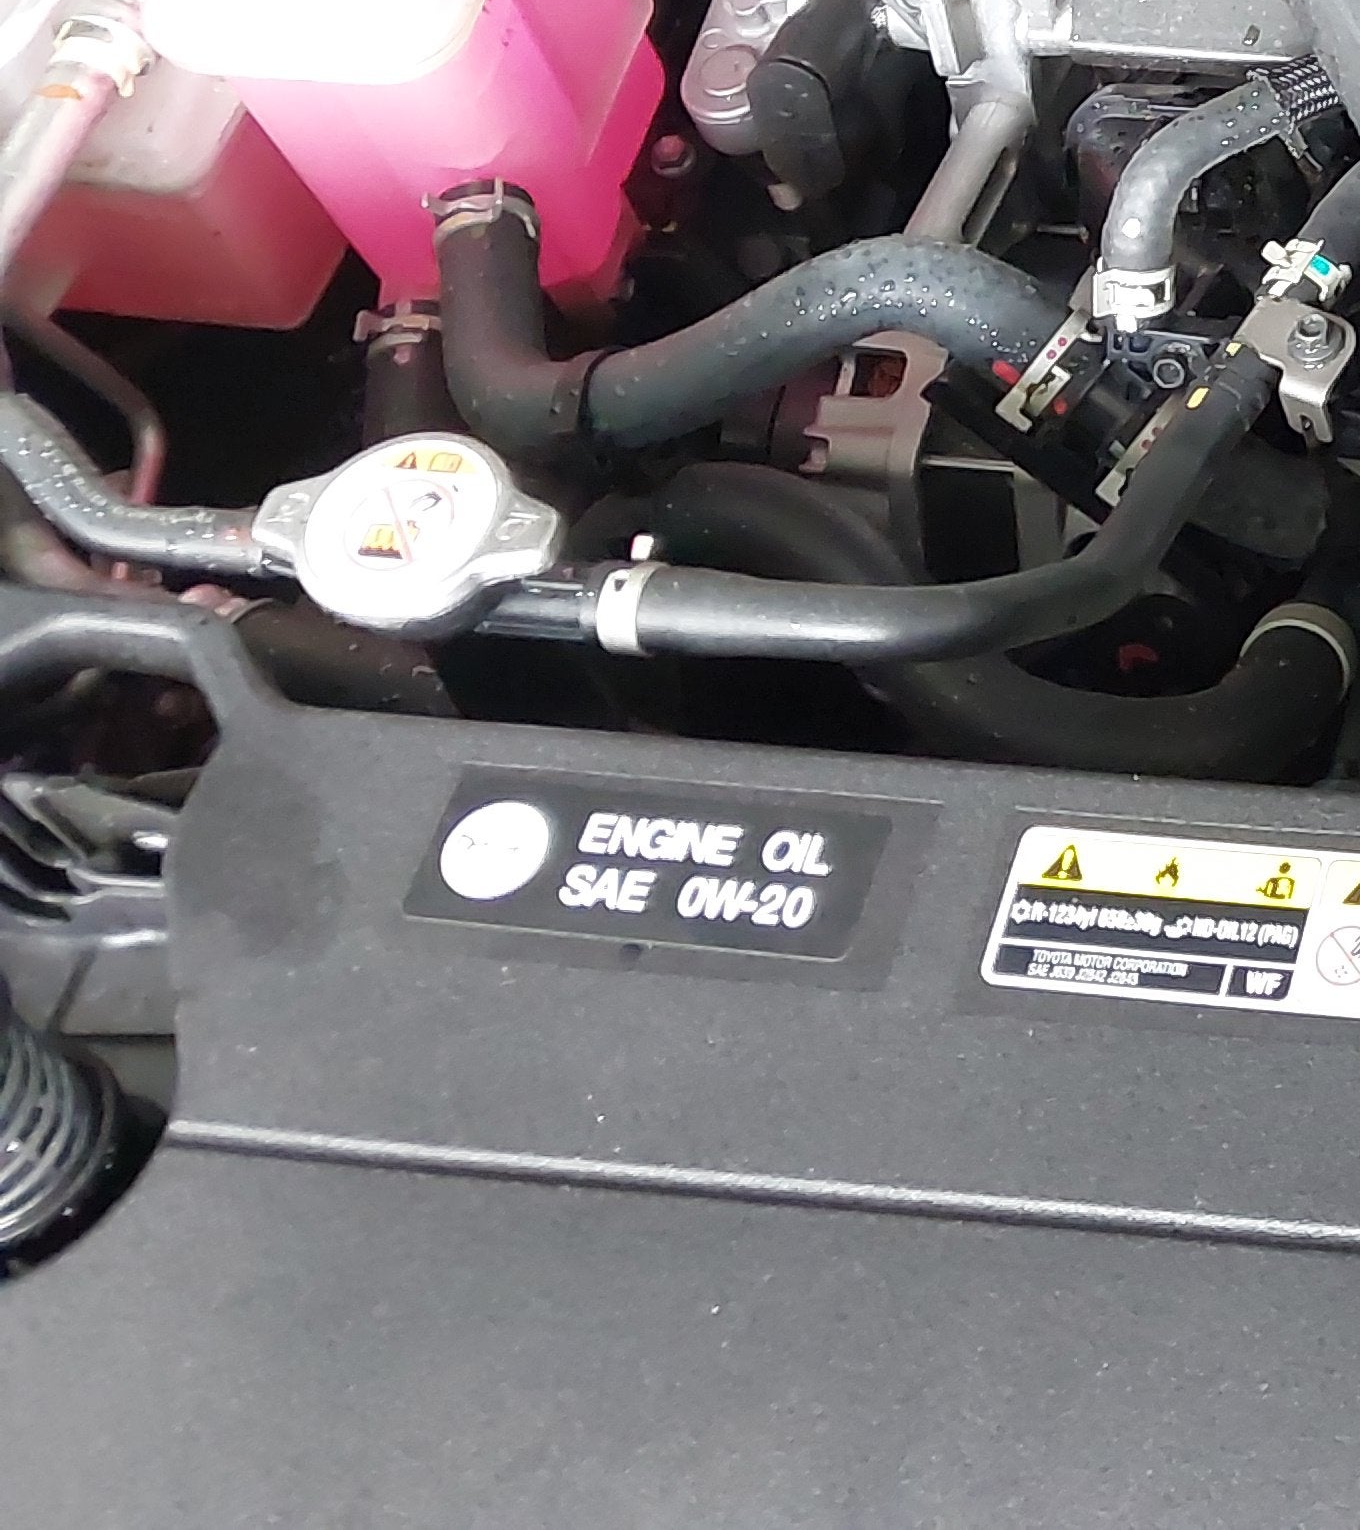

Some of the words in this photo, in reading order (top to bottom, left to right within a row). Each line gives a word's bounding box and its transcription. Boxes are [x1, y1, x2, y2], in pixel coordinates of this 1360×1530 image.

[577, 811, 744, 868] ENGINE
[761, 830, 832, 877] OIL
[557, 864, 659, 914] SAE
[676, 874, 817, 930] 0W-20
[1027, 962, 1051, 977] SAE
[1033, 948, 1073, 965] TOYOTA
[1073, 953, 1113, 970] MOTOR
[1112, 956, 1190, 977] CORPORATION
[1245, 969, 1284, 996] WF
